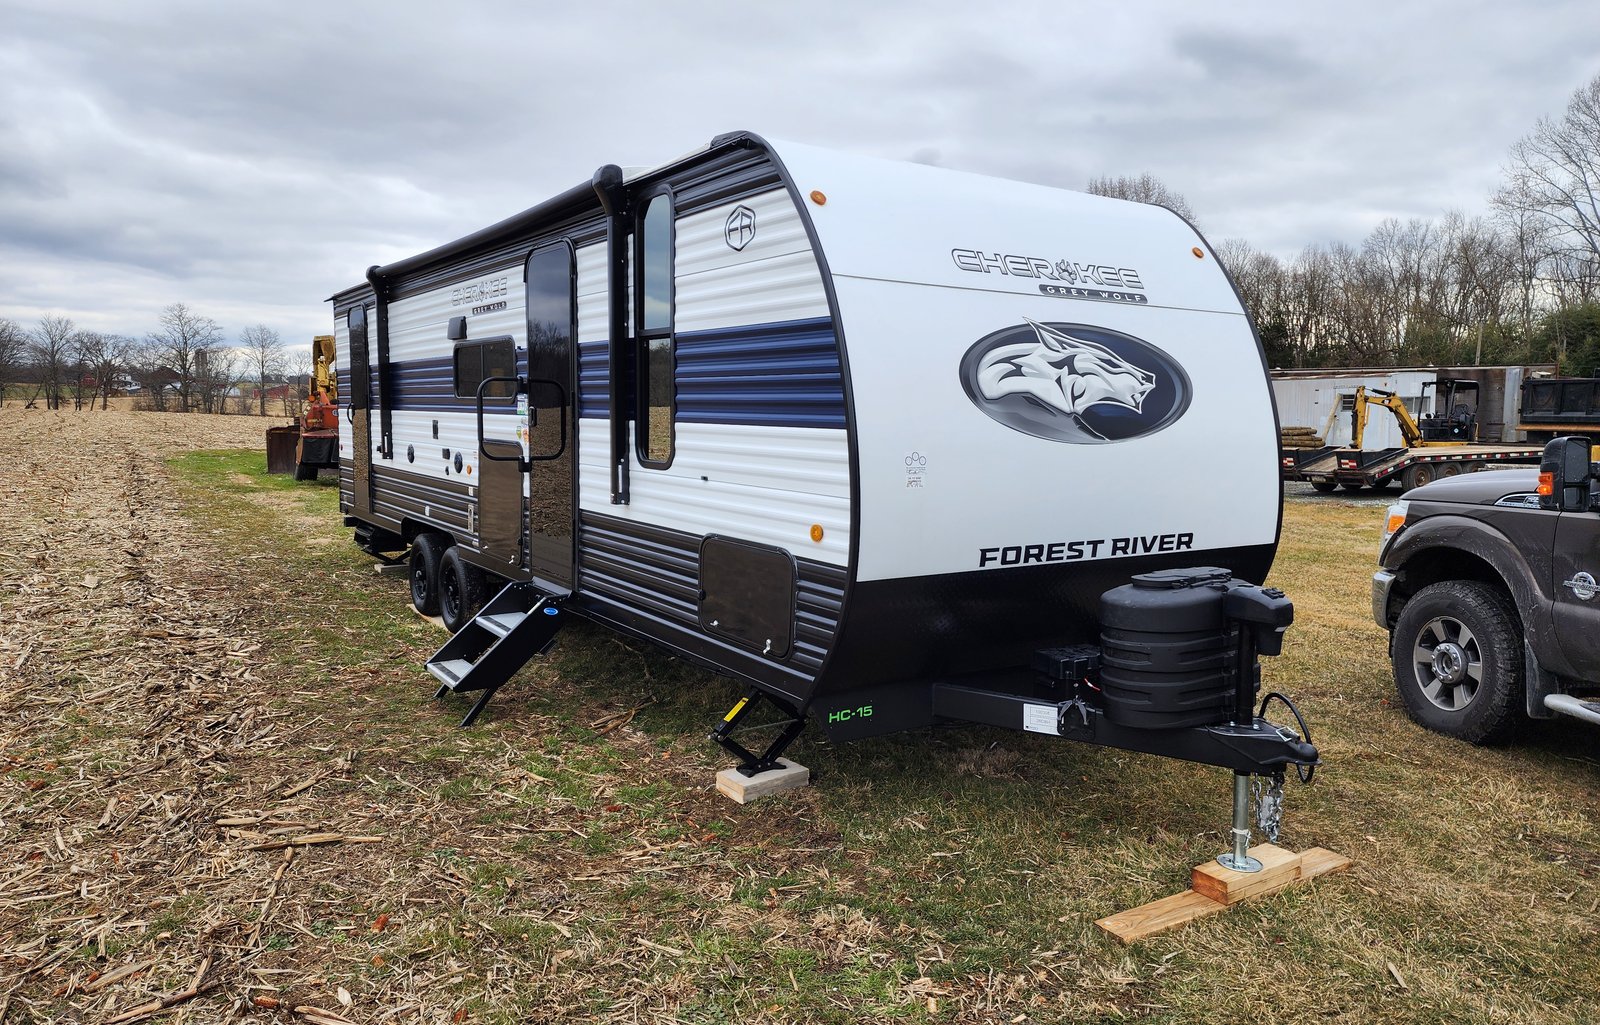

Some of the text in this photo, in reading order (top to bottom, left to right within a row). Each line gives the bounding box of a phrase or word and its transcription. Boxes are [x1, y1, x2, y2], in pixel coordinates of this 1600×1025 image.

[1047, 286, 1142, 302] GREY WOLF
[473, 301, 505, 315] GREY WOLF
[979, 532, 1194, 567] FOREST RIVER
[828, 705, 873, 723] HC-15
